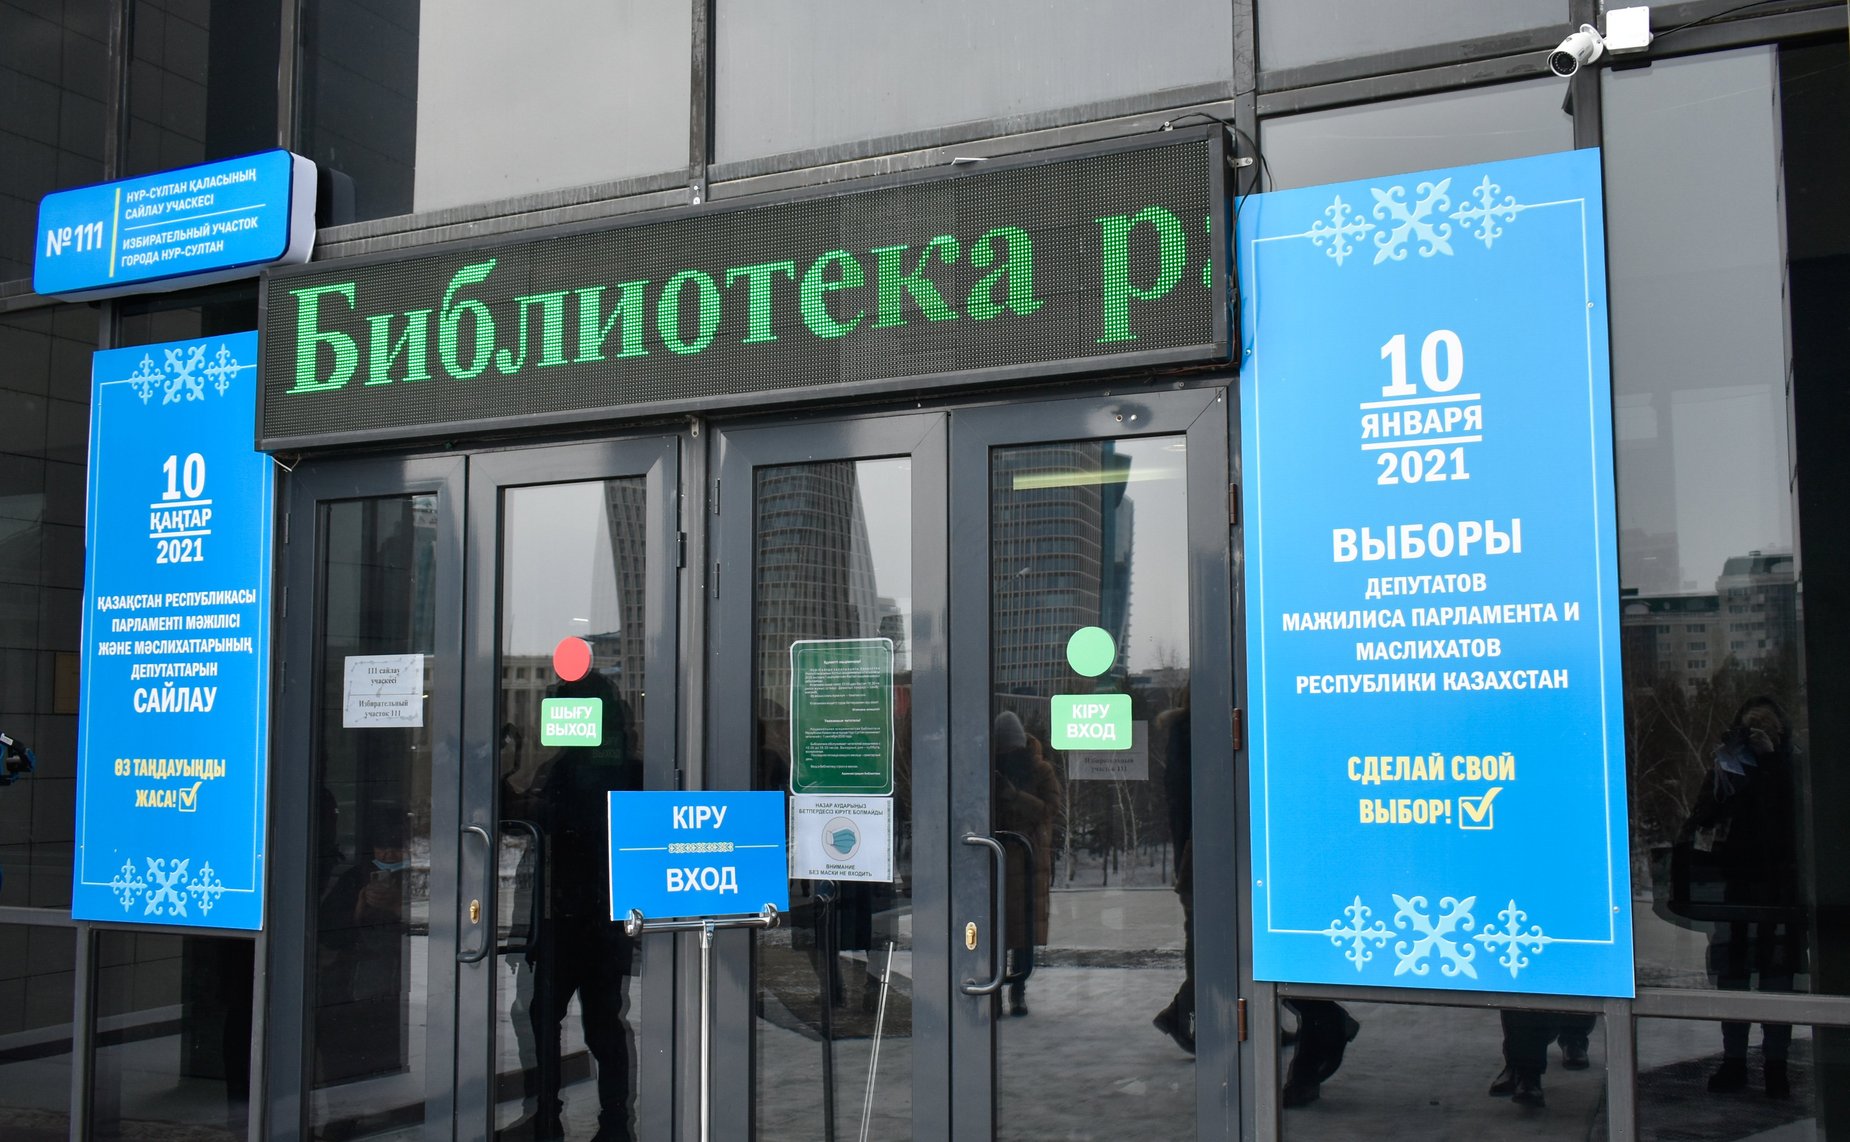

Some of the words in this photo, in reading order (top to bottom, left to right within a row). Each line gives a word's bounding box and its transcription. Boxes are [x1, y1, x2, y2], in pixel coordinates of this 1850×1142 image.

[189, 169, 256, 192] ҚАЛАСЫНЫҢ
[126, 203, 164, 219] САЙЛАУ
[167, 194, 214, 213] УЧАСКЕСІ
[123, 224, 209, 250] ИЗБИРАТЕЛЬНЫЙ
[213, 217, 258, 234] УЧАСТОК
[122, 251, 159, 267] ГОРОДА
[162, 240, 224, 260] НУР-СУЛТАН
[285, 225, 1044, 394] Библиотека
[1381, 329, 1464, 397] 10
[1361, 405, 1482, 439] ЯНВАРЯ
[162, 453, 206, 500] 10
[1377, 447, 1470, 485] 2021
[150, 508, 212, 533] ҚАҢТАР
[156, 538, 204, 564] 2021
[1333, 518, 1522, 562] ВЫБОРЫ
[1365, 573, 1487, 599] ДЕПУТАТОВ
[97, 594, 162, 612] ҚАЗАҚСТАН
[165, 589, 256, 607] РЕСПУБЛИКАСЫ
[112, 616, 183, 632] ПАРЛАМЕНТІ
[186, 614, 240, 630] МӘЖІЛІСІ
[1283, 609, 1405, 631] МАЖИЛИСА
[1412, 603, 1558, 626] ПАРЛАМЕНТА
[1564, 602, 1580, 621] И
[98, 641, 131, 656] ЖӘНЕ
[134, 637, 253, 655] МӘСЛИХАТТАРЫНЫҢ
[1356, 638, 1501, 661] МАСЛИХАТОВ
[131, 662, 218, 680] ДЕПУТАТТАРЫН
[1296, 672, 1436, 694] РЕСПУБЛИКИ
[1443, 669, 1568, 691] КАЗАХСТАН
[133, 681, 217, 713] САЙЛАУ
[551, 706, 593, 719] ШЫҒУ
[1072, 704, 1110, 719] КІРУ
[546, 723, 596, 738] ВЫХОД
[1067, 723, 1116, 741] ВХОД
[114, 759, 131, 776] ӨЗ
[133, 759, 226, 780] ТАҢДАУЫҢДЫ
[1348, 752, 1444, 785] СДЕЛАЙ
[1452, 752, 1515, 780] СВОЙ
[135, 790, 177, 807] ЖАСА!
[673, 806, 727, 829] КІРУ
[1360, 799, 1451, 824] ВЫБОР!
[667, 867, 738, 895] ВХОД
